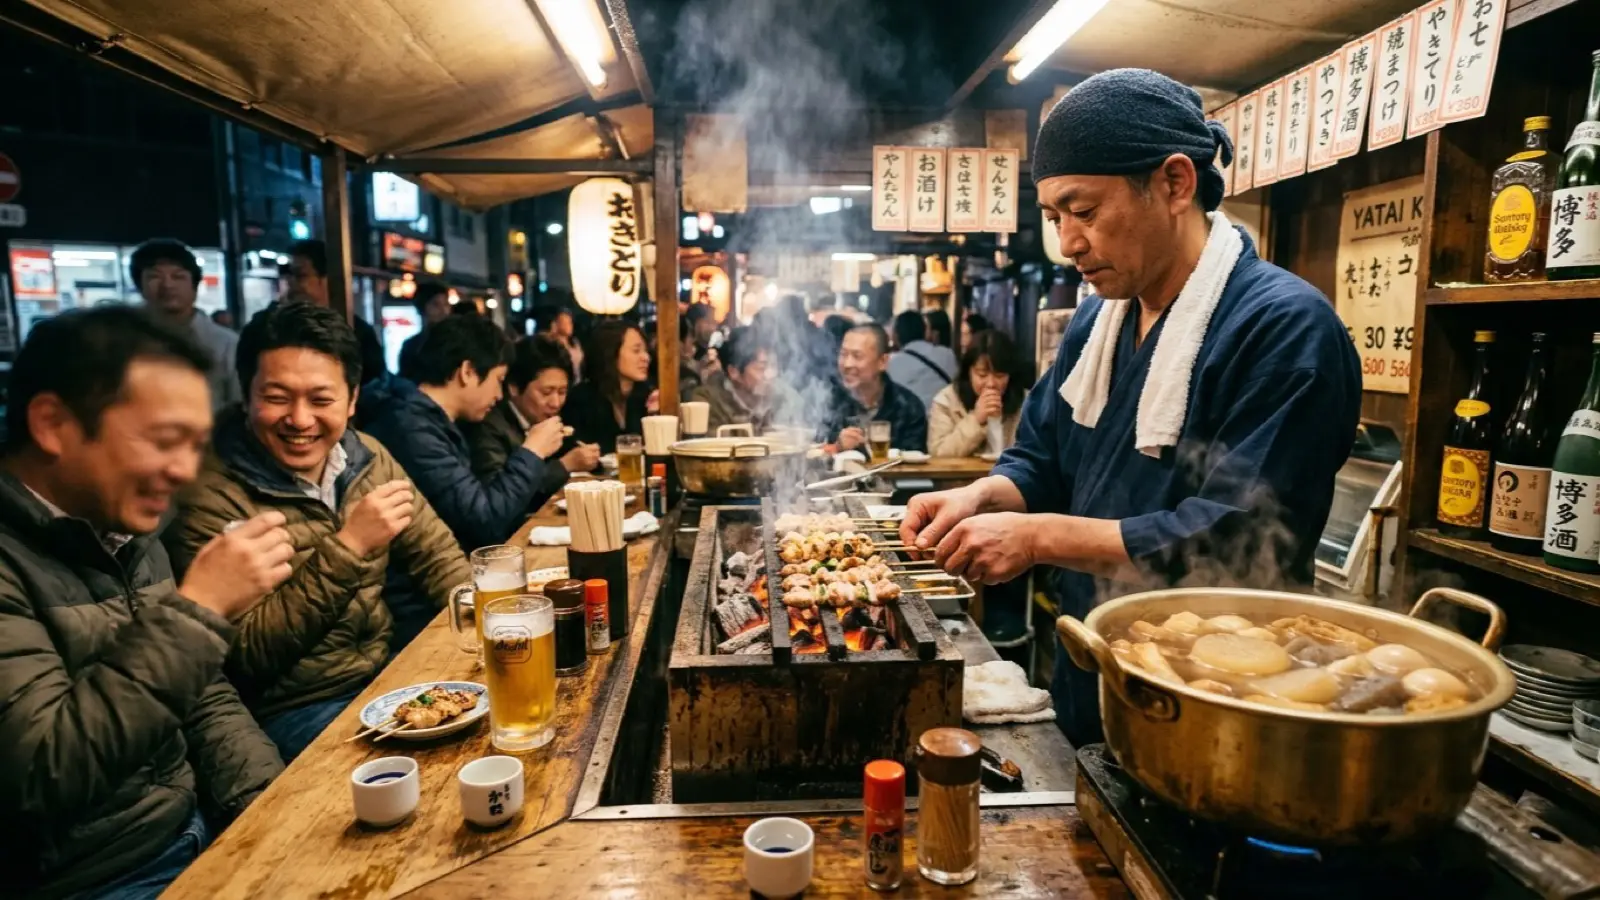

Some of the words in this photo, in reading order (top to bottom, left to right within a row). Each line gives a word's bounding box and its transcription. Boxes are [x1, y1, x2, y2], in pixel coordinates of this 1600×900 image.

[917, 153, 937, 213] お酒け
[1353, 198, 1405, 231] YATAI
[1553, 194, 1584, 259] 博多
[1364, 326, 1386, 350] 30
[1548, 478, 1589, 553] 博多酒
